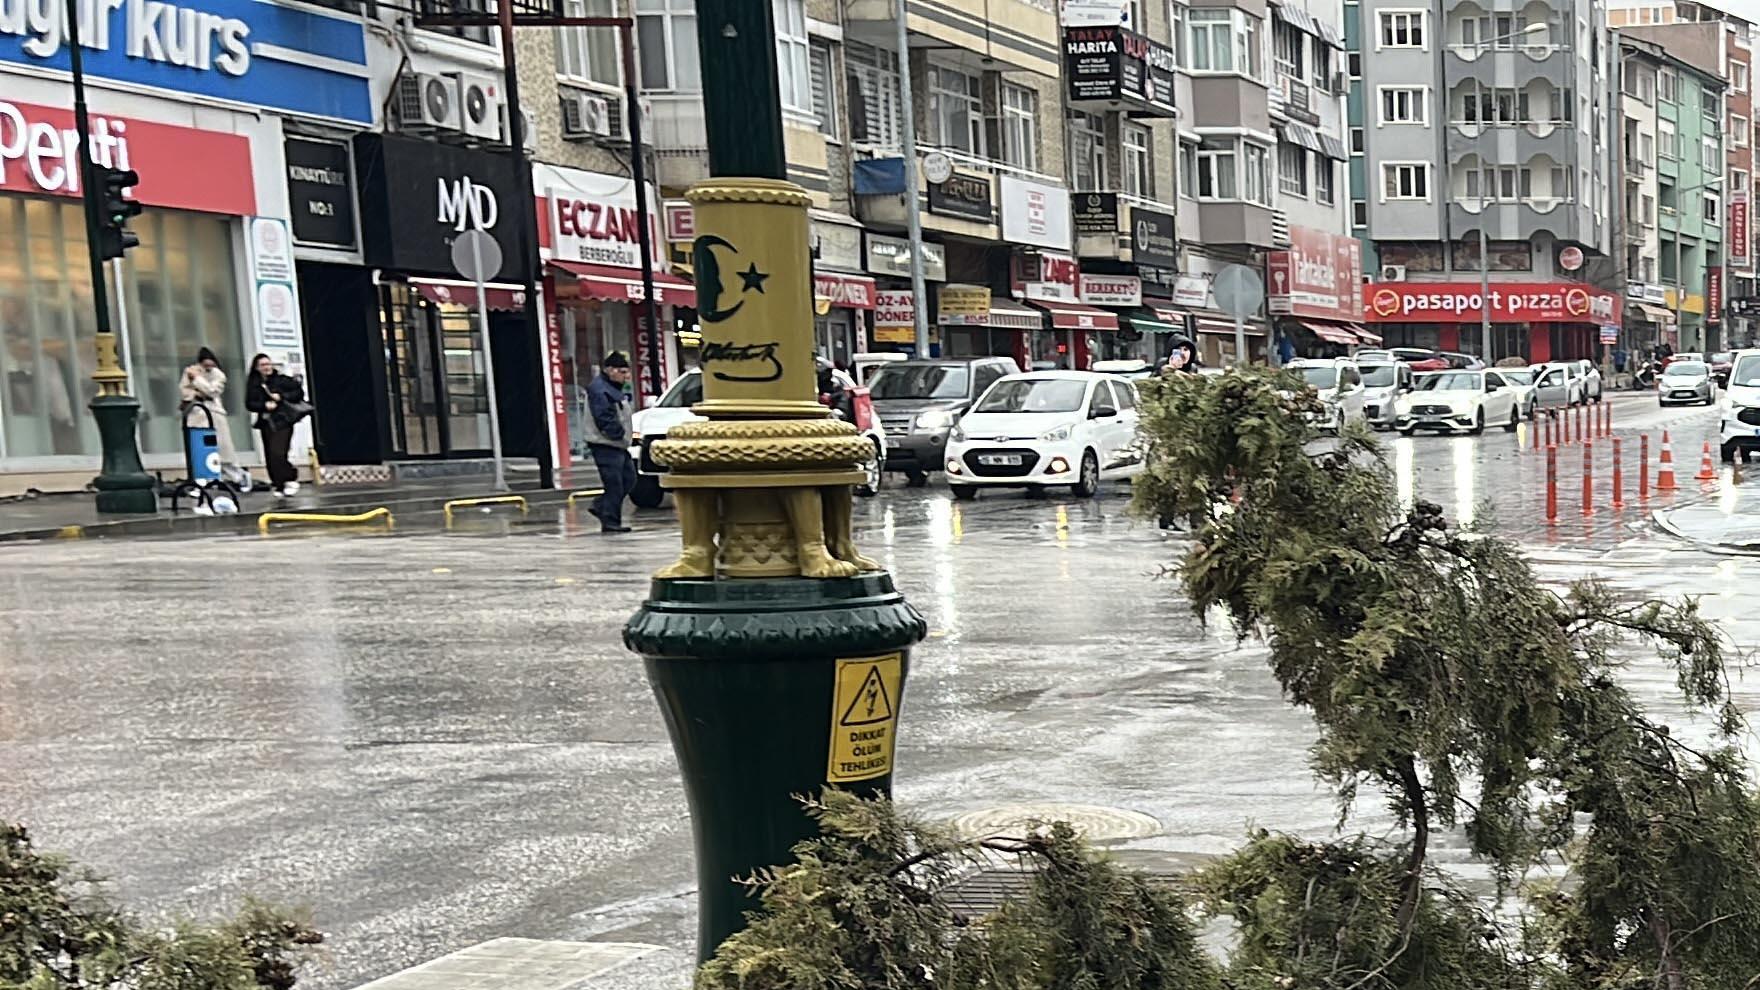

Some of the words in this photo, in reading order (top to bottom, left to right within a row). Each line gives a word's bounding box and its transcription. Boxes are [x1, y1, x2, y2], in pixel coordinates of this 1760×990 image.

[125, 0, 250, 76] kurs
[557, 198, 641, 244] ECZAN
[579, 245, 634, 265] BERBEROĞLU
[1508, 293, 1563, 314] pizza
[548, 313, 566, 415] ECZANE
[850, 727, 886, 742] DİKKAT
[852, 743, 882, 757] ÖLÜM
